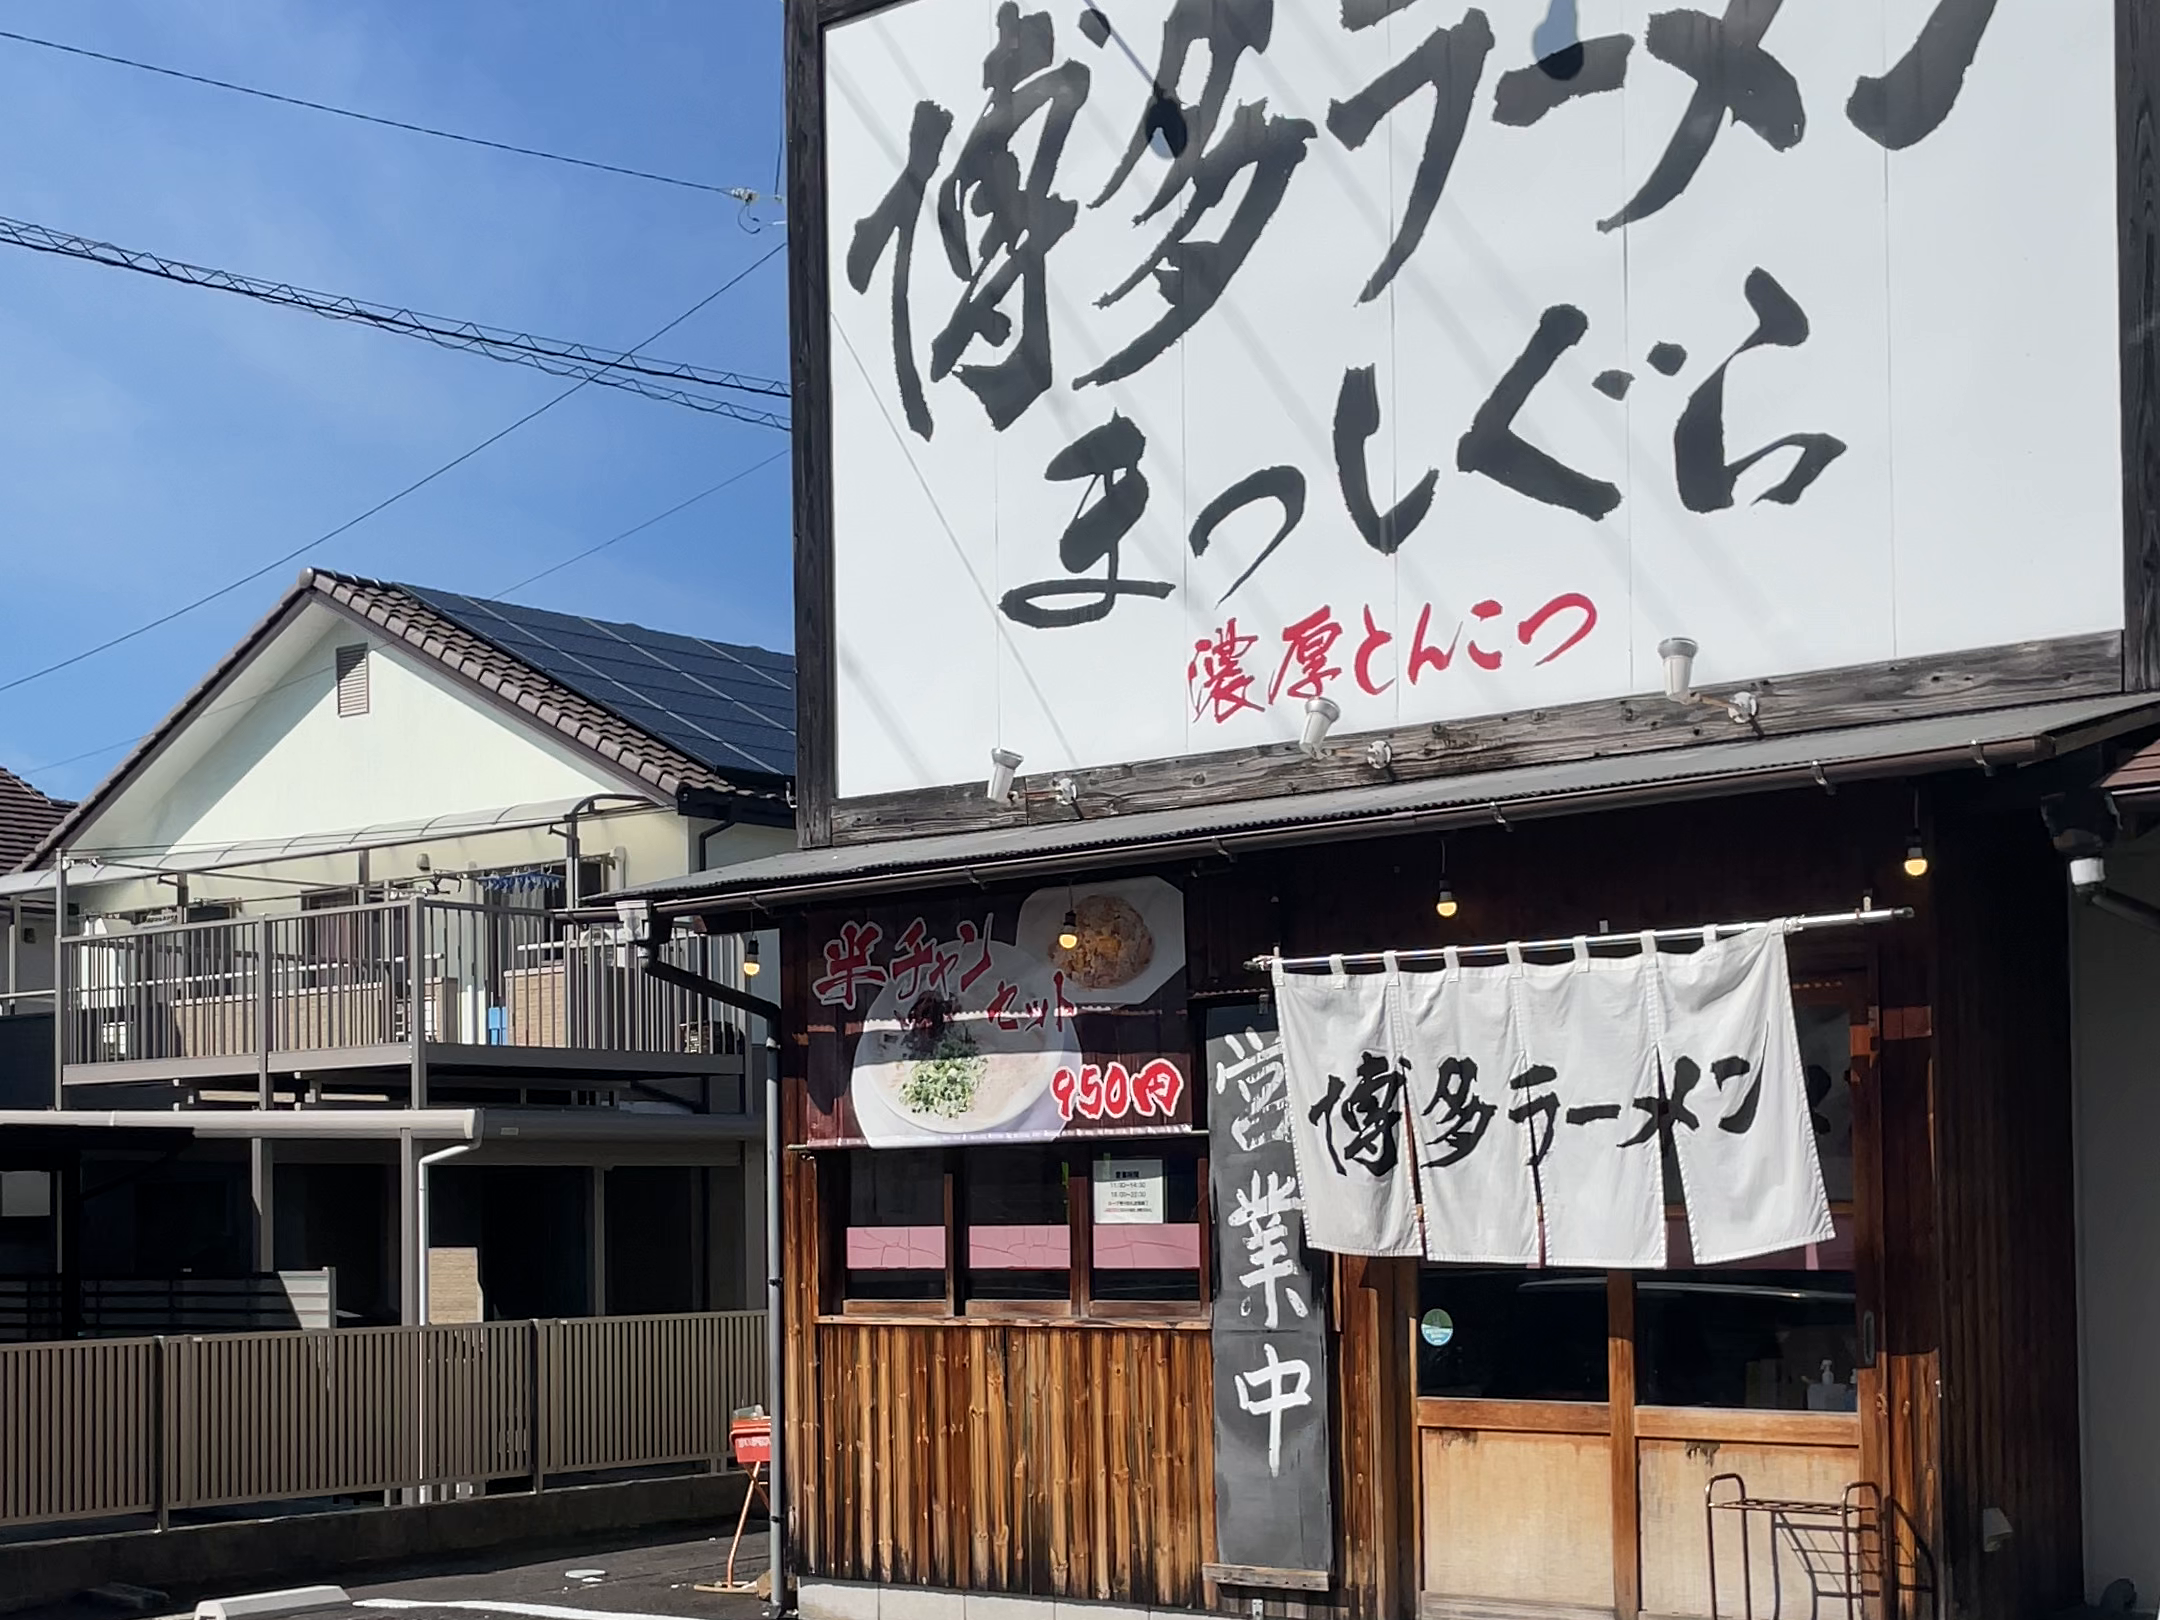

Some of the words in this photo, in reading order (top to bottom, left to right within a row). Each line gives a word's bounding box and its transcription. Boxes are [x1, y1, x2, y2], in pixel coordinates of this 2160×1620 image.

[998, 266, 1847, 628] まっしぐら
[1187, 592, 1597, 723] 濃厚とんこつ
[813, 912, 994, 1010] 半チャン
[987, 970, 1078, 1033] セット
[1050, 1057, 1184, 1121] 950円
[1309, 1020, 1770, 1177] 博多ラーメン
[1216, 1026, 1312, 1478] 営業中
